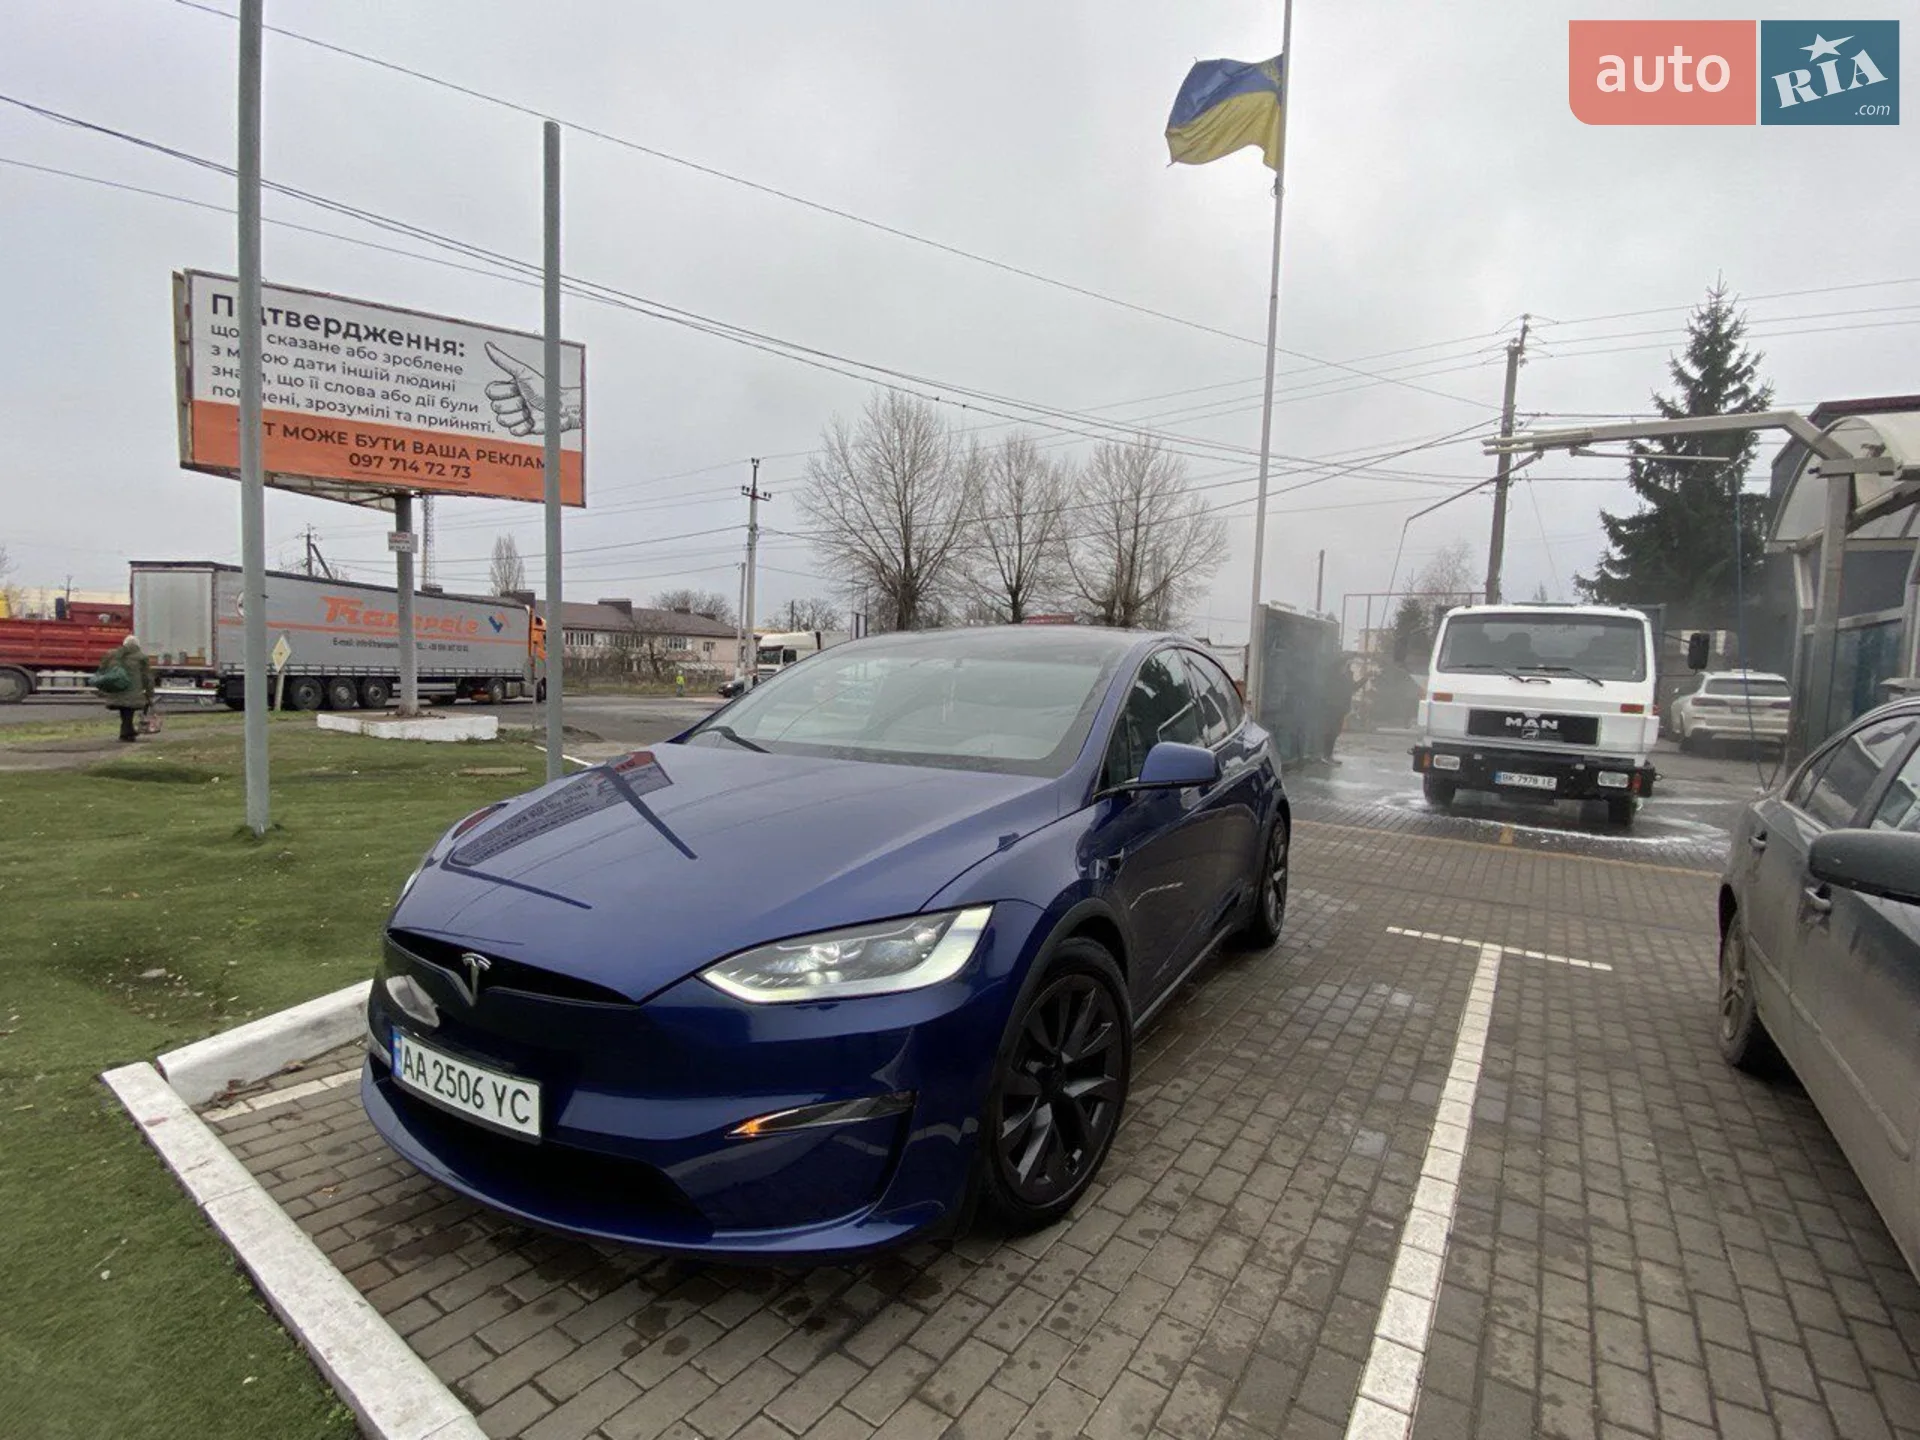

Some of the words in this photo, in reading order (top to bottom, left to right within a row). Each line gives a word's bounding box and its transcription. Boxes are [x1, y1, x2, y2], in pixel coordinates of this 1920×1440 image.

[212, 293, 465, 358] Птвердження:
[211, 345, 221, 356] з
[227, 347, 289, 366] мою
[293, 357, 336, 374] дати
[341, 361, 390, 381] іншій
[394, 375, 456, 392] людині
[266, 333, 341, 354] сказане
[346, 345, 377, 361] або
[383, 352, 463, 376] зроблене
[277, 374, 305, 388] що
[309, 375, 319, 390] її
[324, 380, 376, 398] слова
[380, 388, 412, 404] або
[415, 394, 436, 408] дії
[440, 397, 479, 413] були
[304, 397, 390, 419] зрозумілі
[394, 410, 412, 423] та
[417, 414, 495, 434] прийняті.
[282, 424, 349, 446] МОЖЕ
[355, 433, 406, 452] БУТИ
[412, 441, 471, 461] ВАША
[476, 449, 548, 470] РЕКЛАМ
[349, 452, 384, 468] 097
[389, 457, 420, 473] 714
[424, 461, 446, 477] 72
[450, 464, 472, 480] 73
[1505, 716, 1559, 730] MAN
[403, 1045, 429, 1088] AA
[432, 1059, 485, 1110] 2506
[491, 1080, 531, 1124] YC
